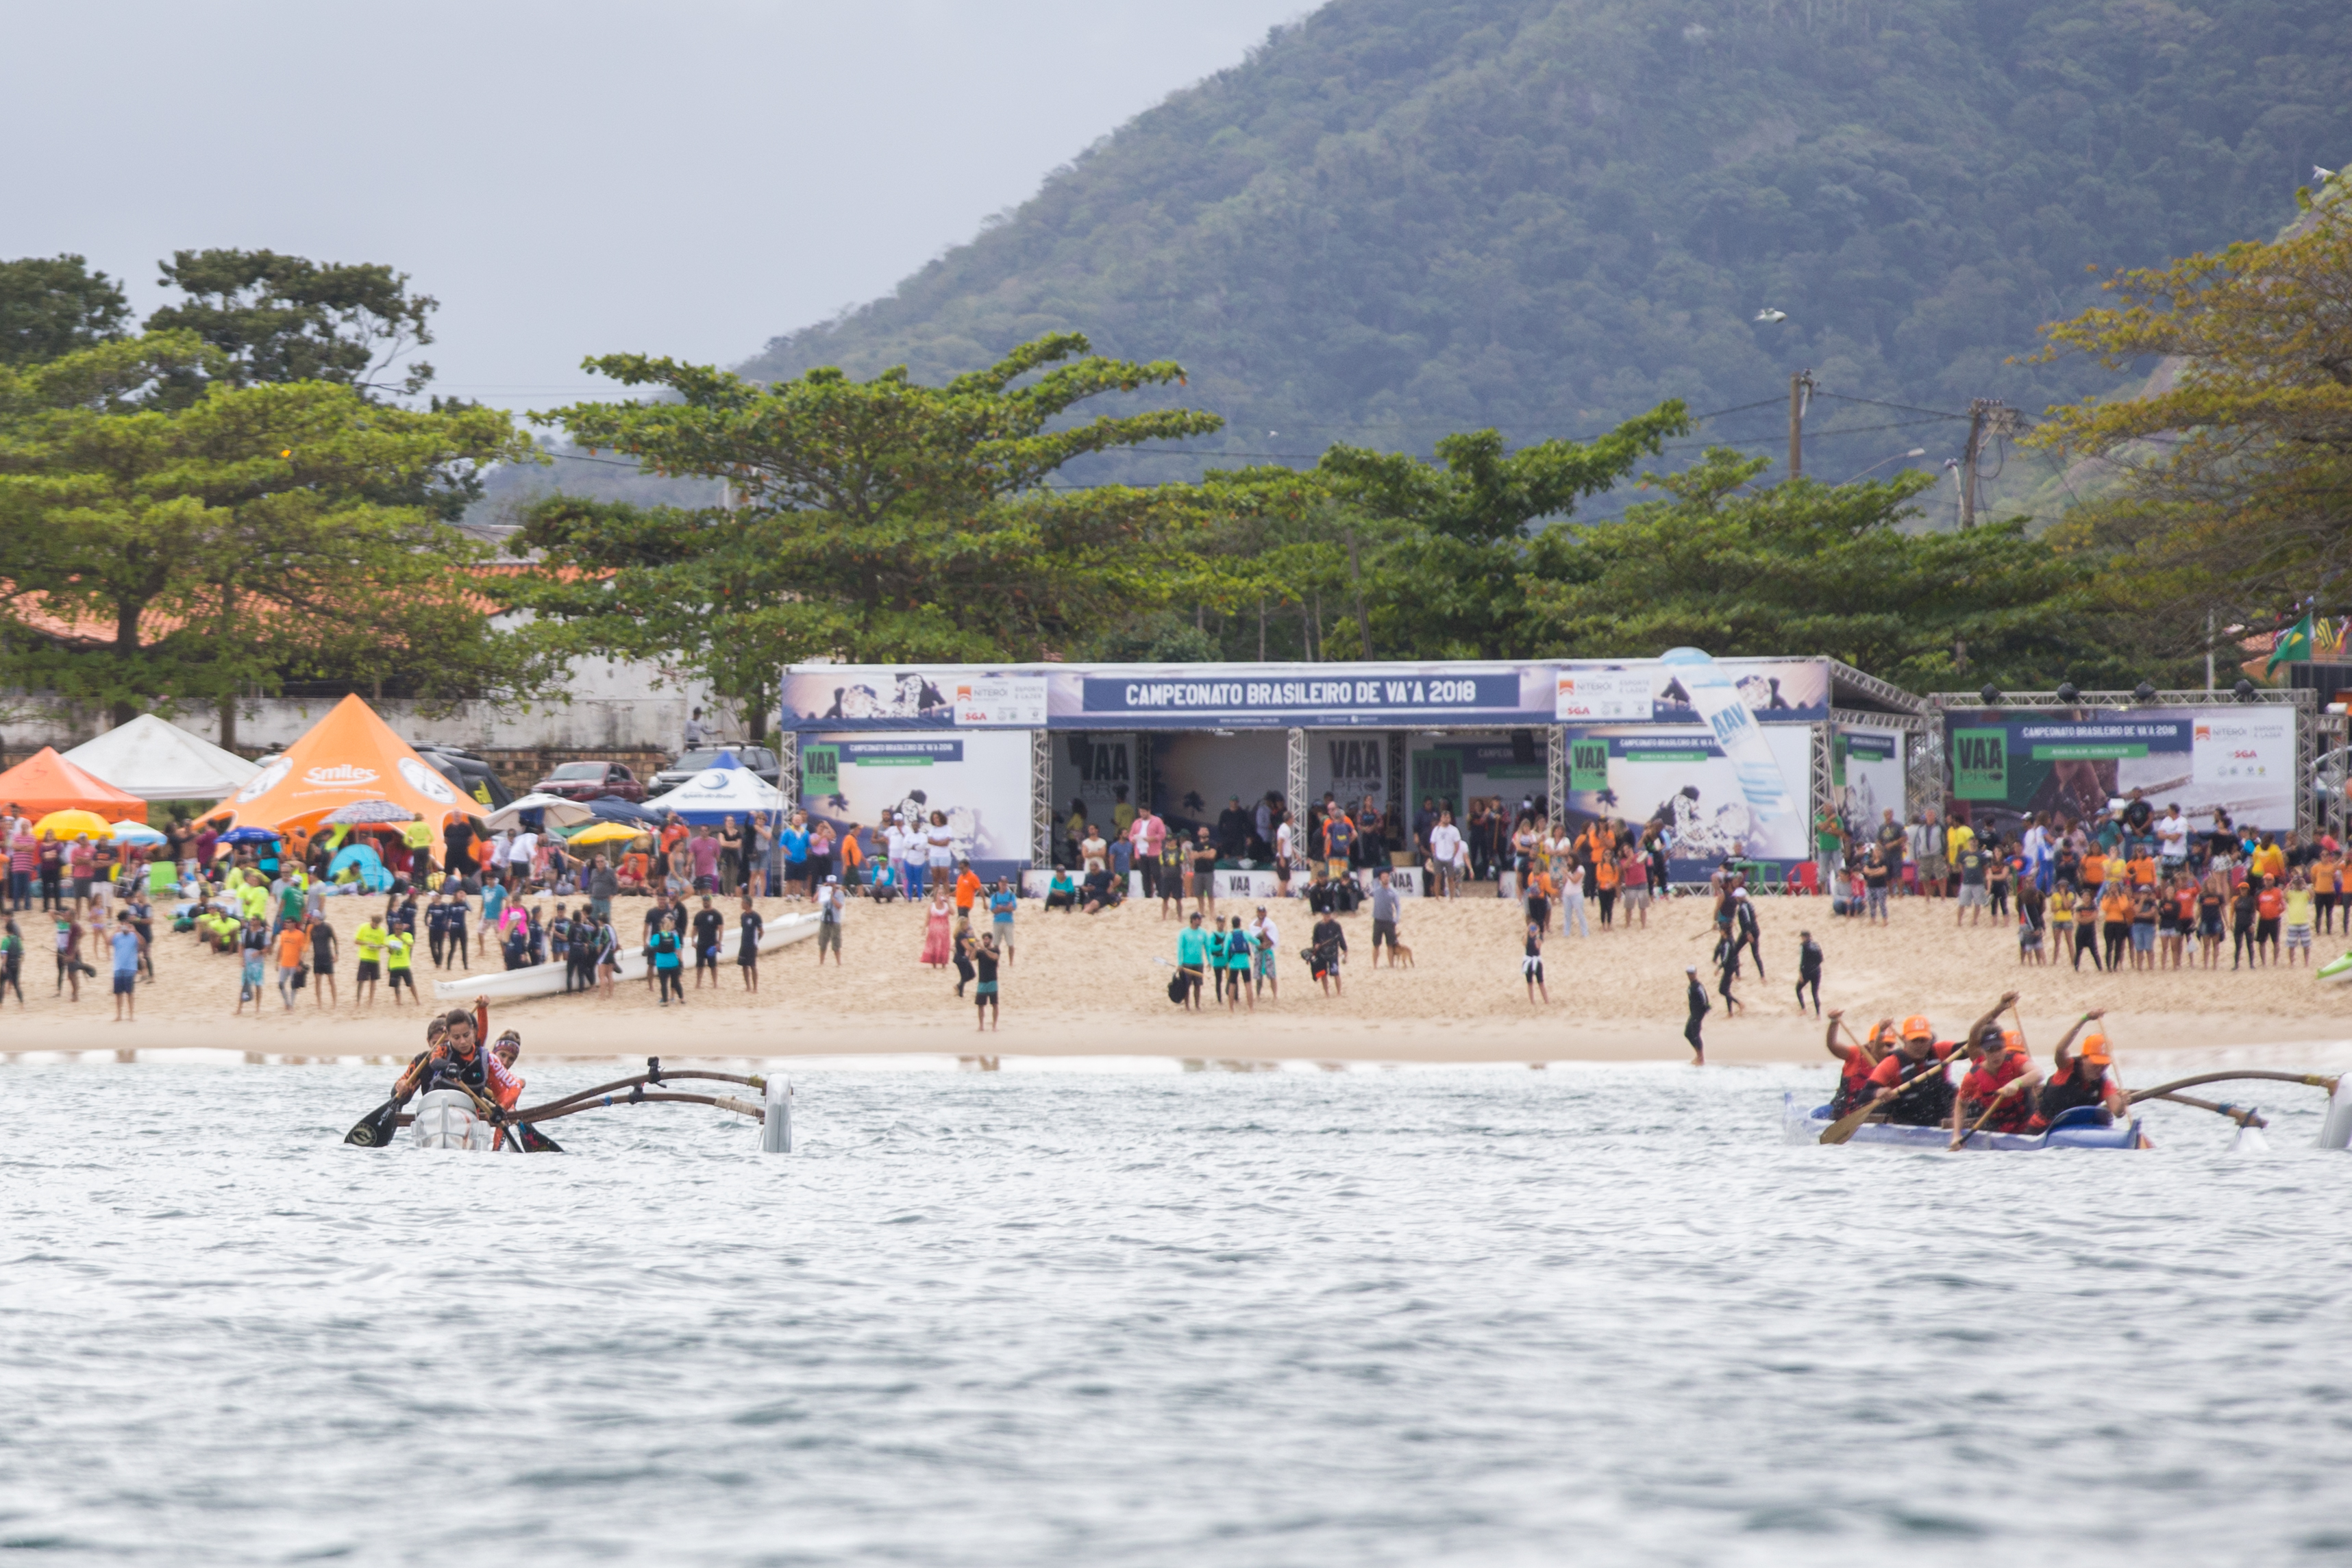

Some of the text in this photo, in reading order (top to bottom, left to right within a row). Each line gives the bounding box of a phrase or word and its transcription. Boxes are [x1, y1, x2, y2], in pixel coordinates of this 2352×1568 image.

[1126, 680, 1476, 706] CAMPEONATO BRASILEIRO DE VA'A 2018
[965, 712, 987, 721] SGA
[1568, 706, 1590, 715] SGA
[2022, 725, 2177, 738] CAMPEONATO BRASILEIRO DE VA'A 2018
[1619, 738, 1657, 747] CAMPEONATO
[1657, 738, 1690, 747] BRASILEIRO
[1329, 741, 1382, 778] VA'A
[1574, 746, 1607, 769] VA'A
[1958, 737, 2004, 769] VA'A
[2234, 749, 2257, 758] SGA
[806, 751, 837, 774] VA'A
